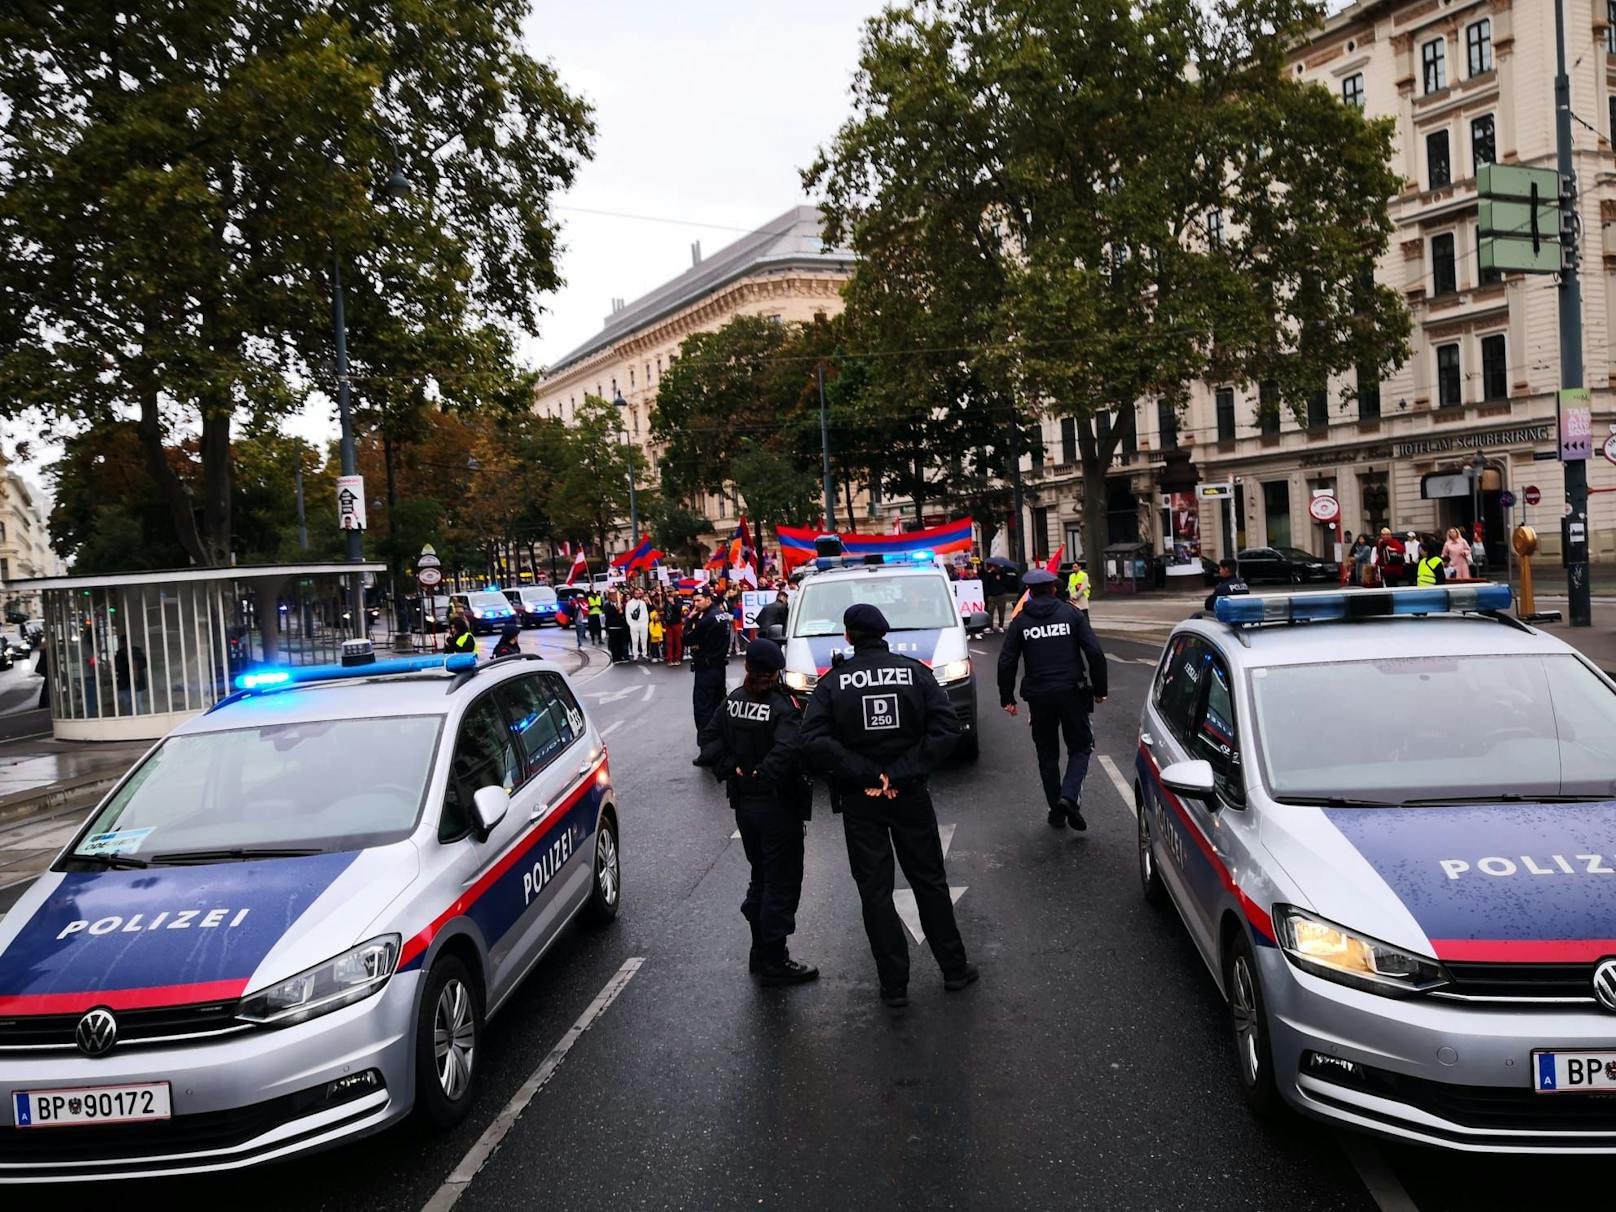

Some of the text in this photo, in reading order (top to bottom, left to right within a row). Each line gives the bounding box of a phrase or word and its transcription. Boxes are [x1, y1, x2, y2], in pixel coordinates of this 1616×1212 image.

[1399, 439, 1433, 457] HOTEL
[1435, 437, 1453, 452] AM
[1456, 426, 1547, 449] SCHUBERTRING
[744, 594, 768, 607] EU
[1022, 623, 1071, 640] POLIZEI
[839, 667, 914, 690] POLIZEI
[873, 699, 889, 715] D
[871, 715, 893, 726] 250
[523, 827, 573, 906] POLIZEI
[1439, 854, 1616, 880] POLIZ
[56, 907, 251, 940] POLIZEI
[1543, 1076, 1553, 1085] A
